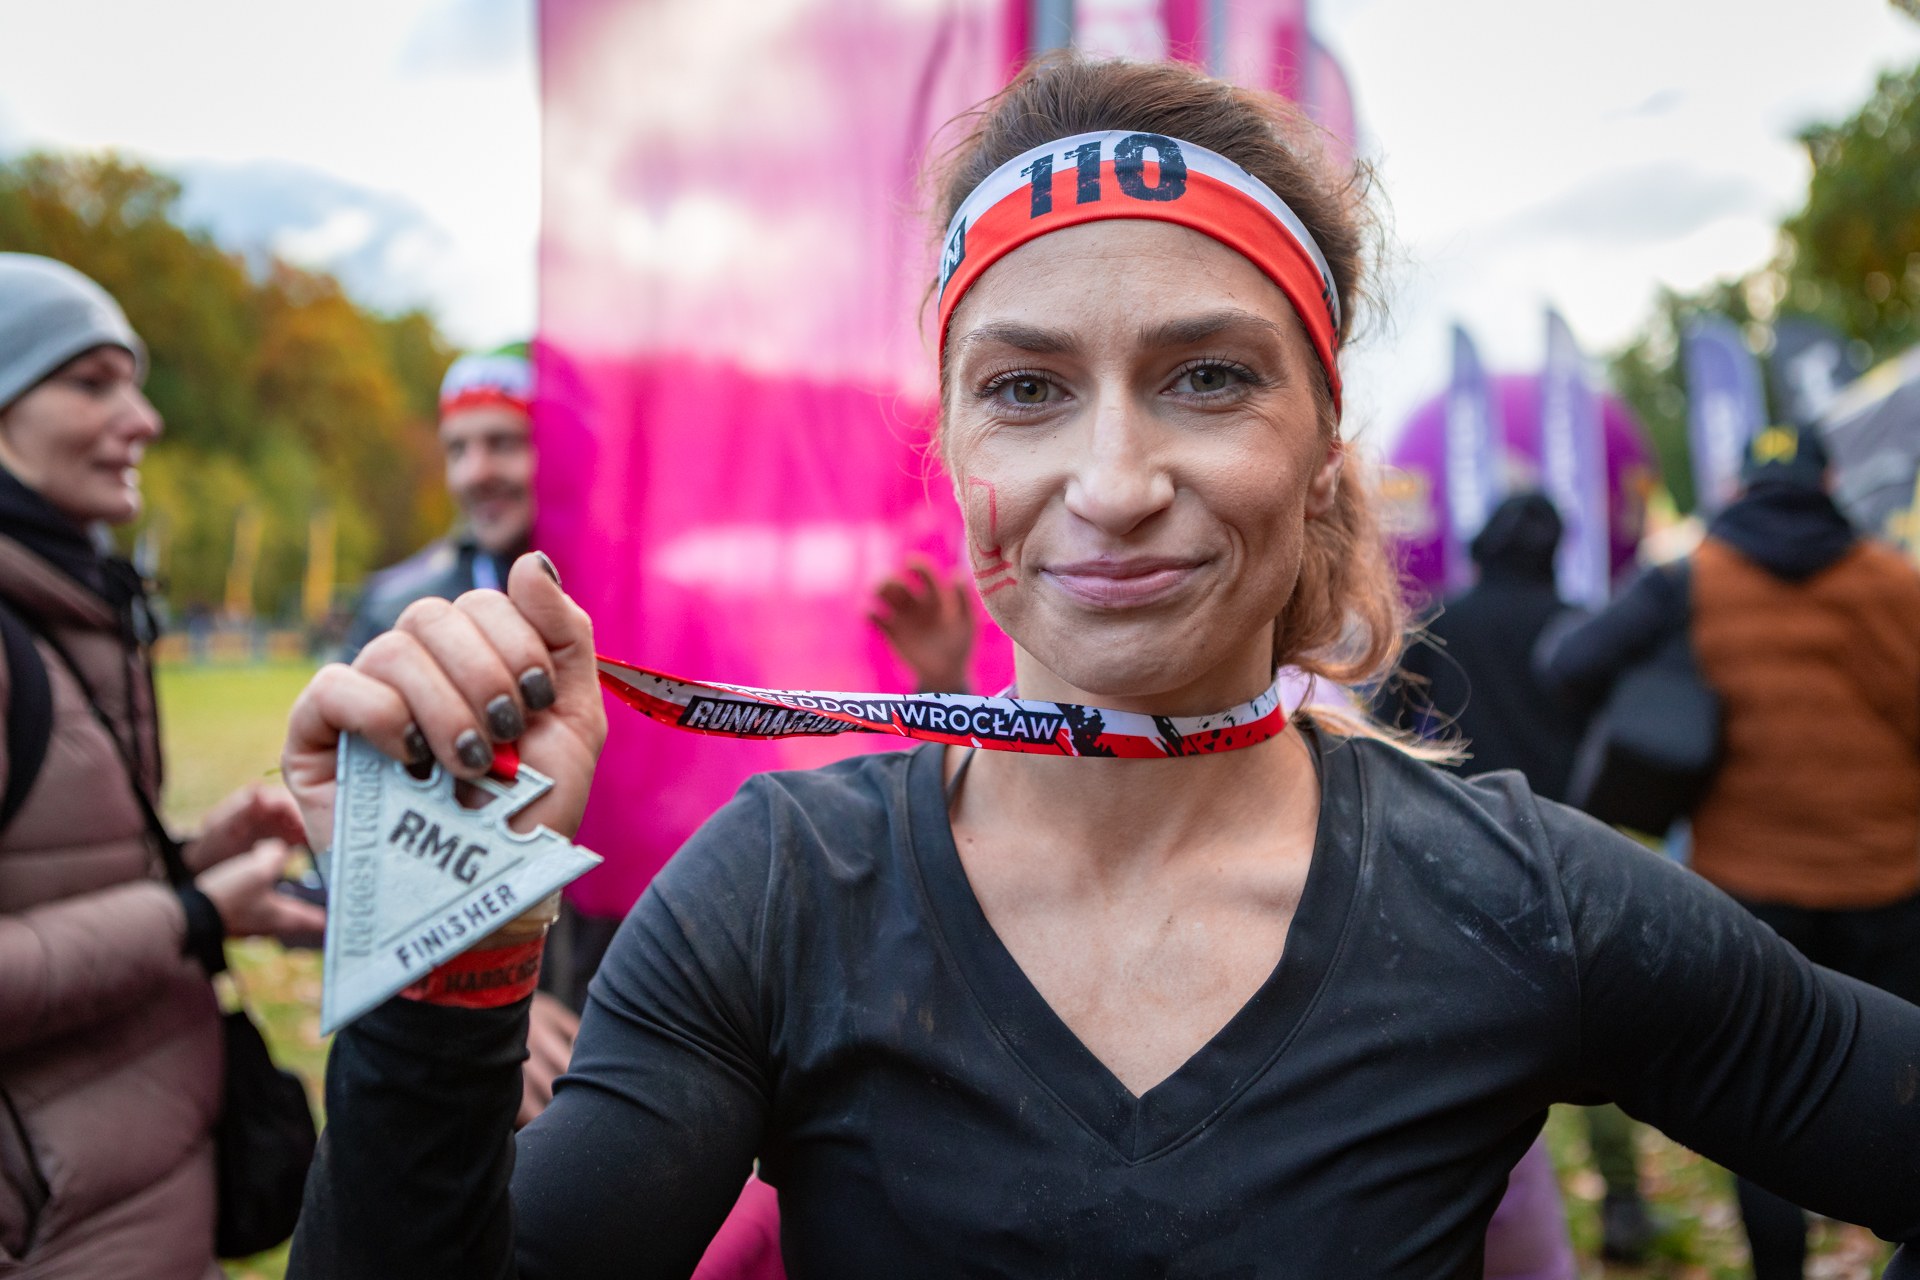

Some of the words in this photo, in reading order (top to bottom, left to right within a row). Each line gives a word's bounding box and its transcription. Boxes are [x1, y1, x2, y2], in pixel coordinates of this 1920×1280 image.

[1021, 133, 1188, 219] 110
[896, 702, 1059, 741] WROCŁAW
[388, 808, 490, 886] RMG
[395, 883, 518, 970] FINISHER
